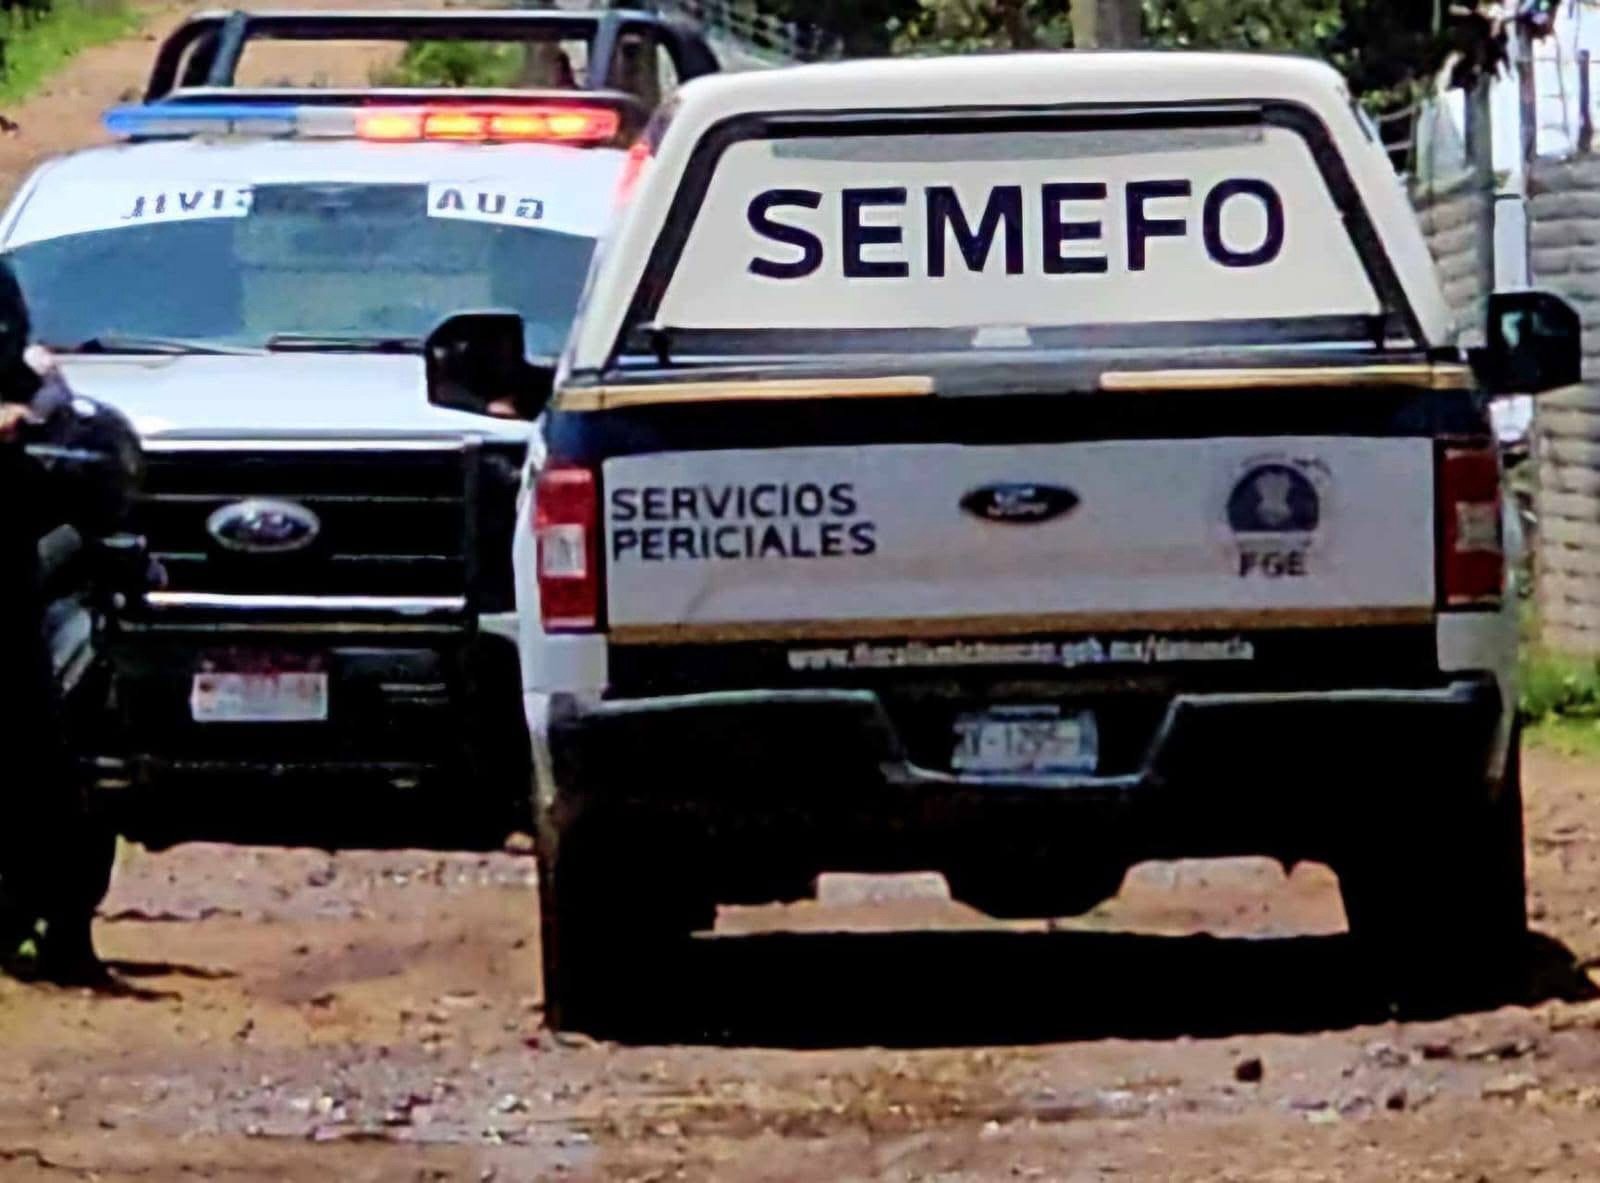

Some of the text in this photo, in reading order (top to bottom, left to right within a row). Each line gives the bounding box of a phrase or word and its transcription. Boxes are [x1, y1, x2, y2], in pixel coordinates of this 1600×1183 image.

[747, 178, 1285, 280] SEMEFO
[611, 482, 858, 522] SERVICIOS
[612, 521, 878, 561] PERICIALES
[1239, 550, 1308, 579] FGE
